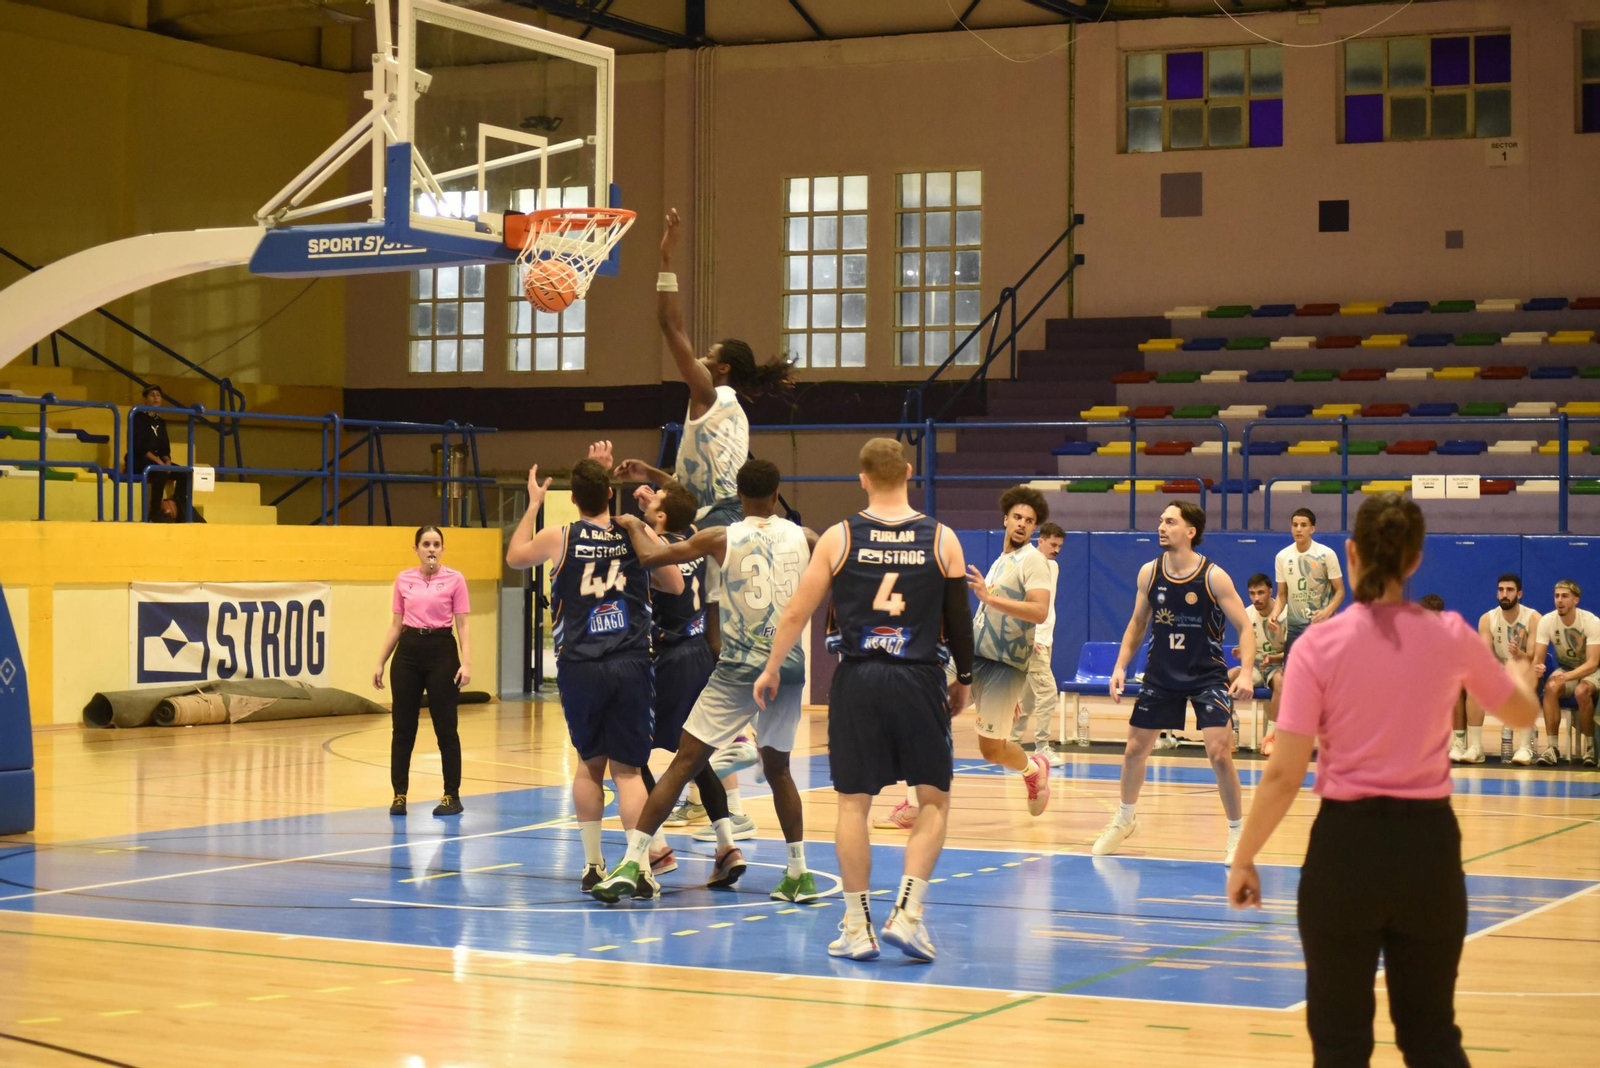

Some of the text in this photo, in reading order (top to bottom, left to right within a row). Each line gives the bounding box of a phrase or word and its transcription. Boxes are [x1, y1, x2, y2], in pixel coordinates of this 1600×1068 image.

[1501, 151, 1507, 161] 1
[870, 530, 915, 542] FURLAN
[596, 544, 628, 558] STROG
[884, 550, 925, 565] STROG
[580, 559, 627, 598] 44
[740, 551, 800, 610] 35
[872, 572, 905, 616] 4
[590, 613, 625, 632] UBAGO
[216, 599, 325, 680] STROG
[1168, 633, 1186, 650] 12
